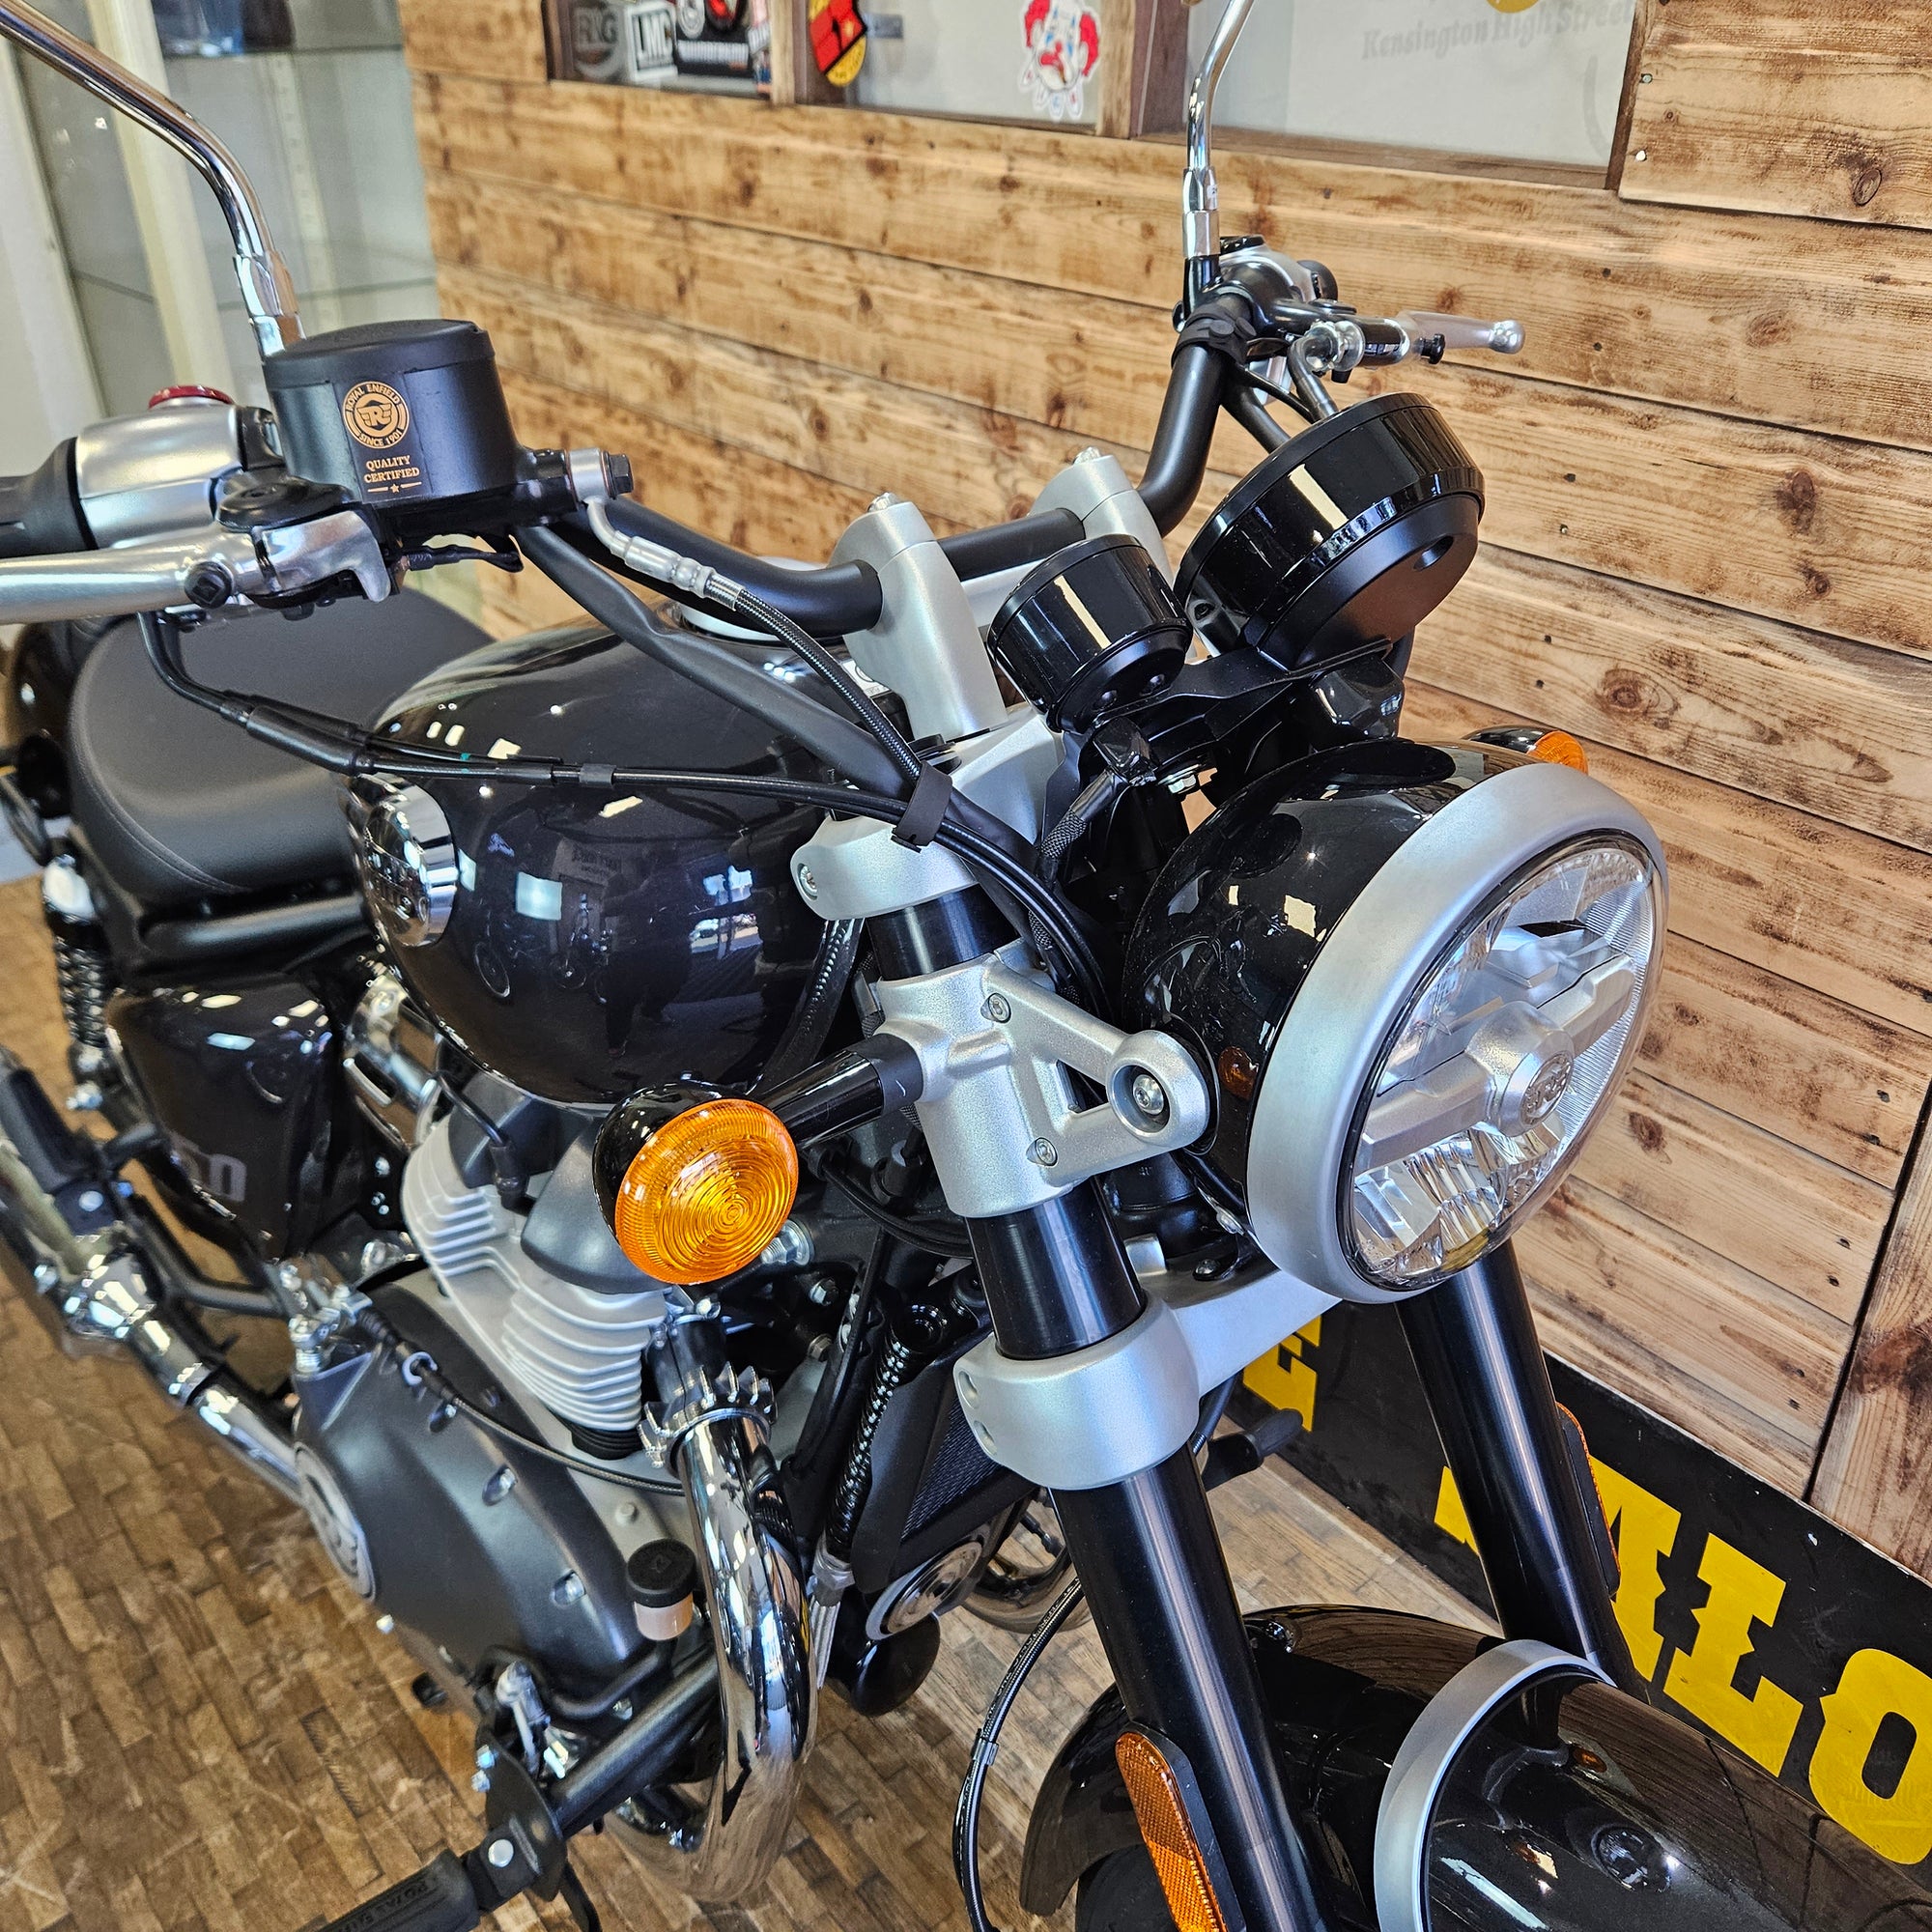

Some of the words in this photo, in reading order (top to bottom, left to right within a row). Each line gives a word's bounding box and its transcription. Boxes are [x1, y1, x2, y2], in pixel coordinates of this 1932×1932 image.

[1361, 20, 1489, 60] Kensington
[1492, 5, 1552, 47] High
[346, 386, 365, 412] ROYAL
[366, 384, 401, 405] ENFIELD
[358, 432, 384, 447] SINCE
[385, 427, 403, 445] 1901
[366, 455, 411, 471] QUALITY
[363, 468, 420, 483] CERTIFIED
